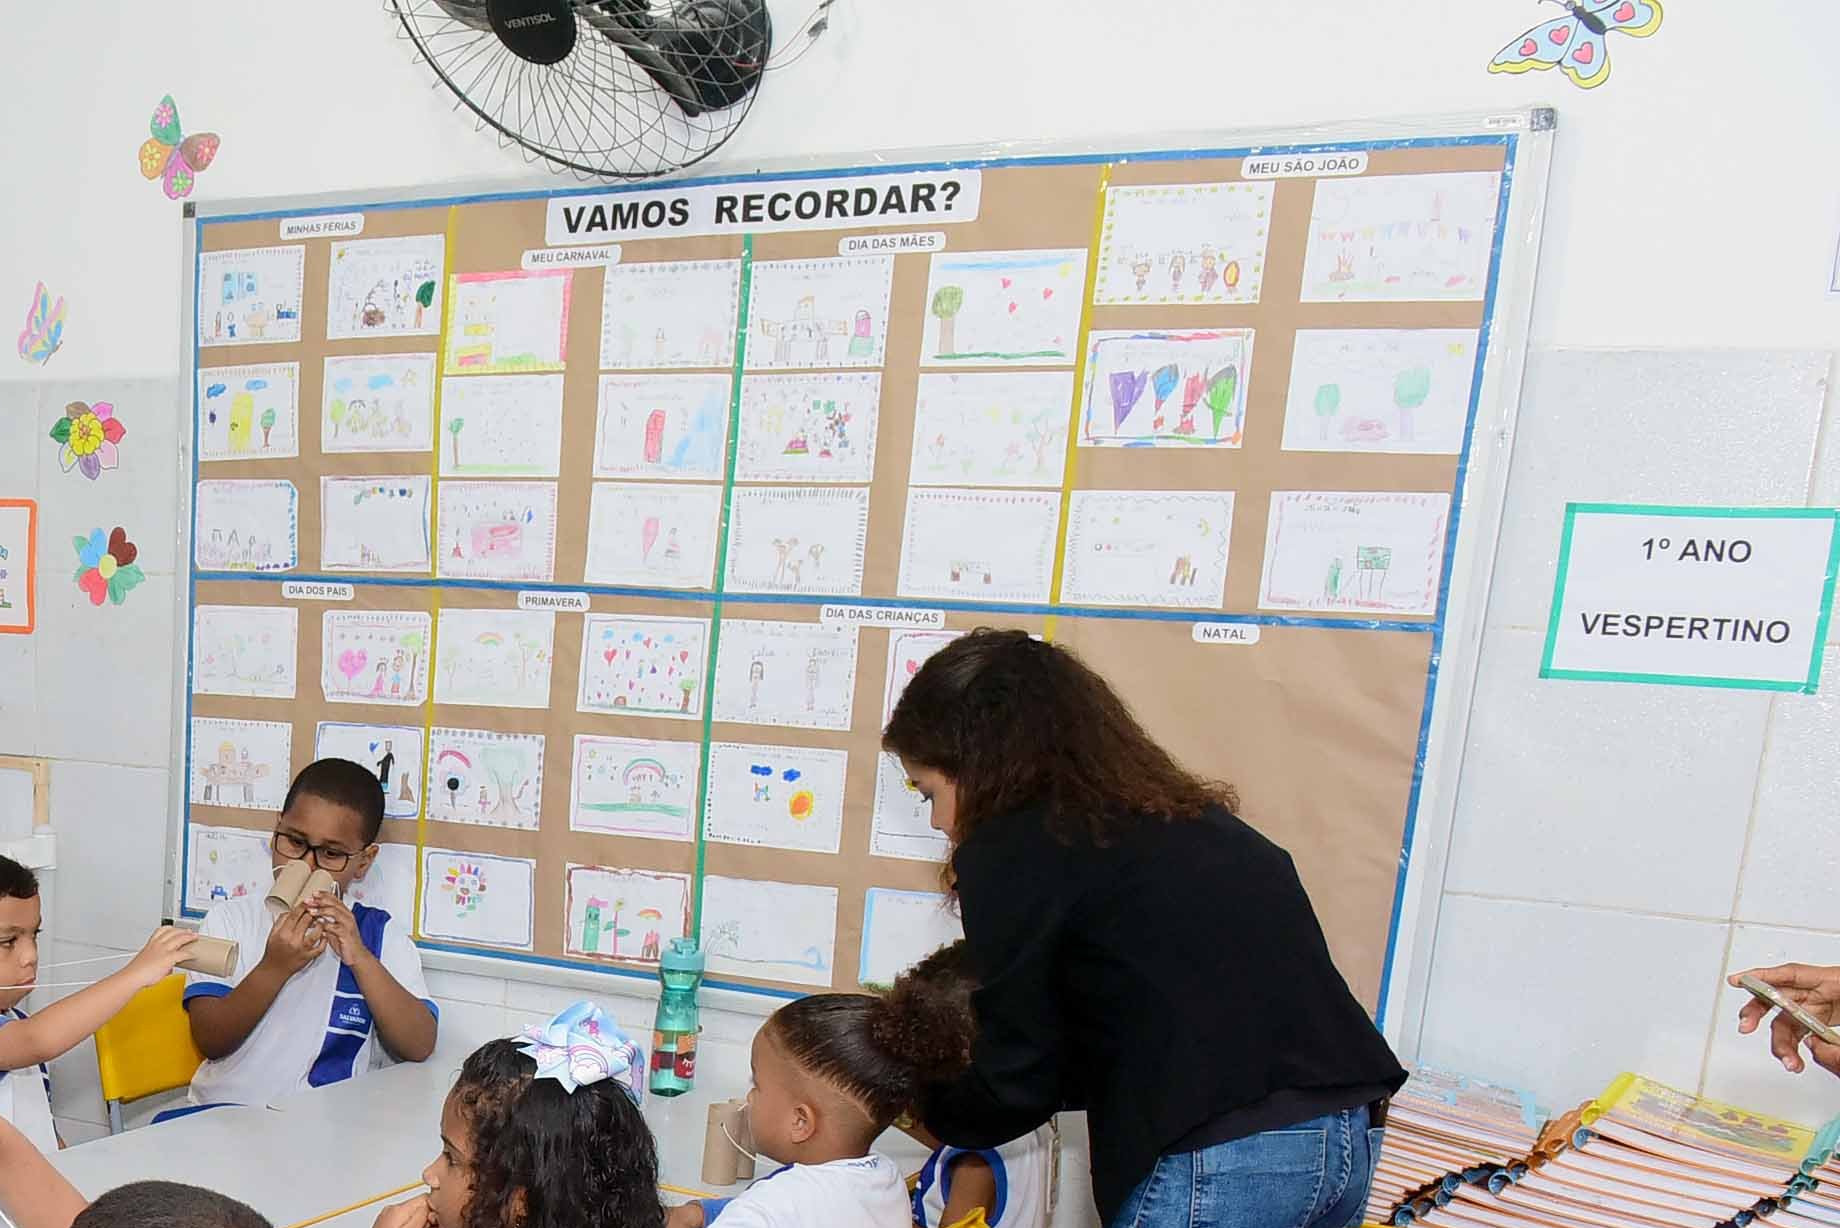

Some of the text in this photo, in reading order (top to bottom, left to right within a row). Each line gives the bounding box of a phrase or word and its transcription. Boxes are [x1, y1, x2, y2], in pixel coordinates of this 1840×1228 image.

[504, 12, 556, 29] VENTISOL
[1249, 155, 1360, 174] MEU SÃO JOÃO
[563, 180, 962, 233] VAMOS RECORDAR?
[287, 222, 320, 234] MINHAS
[848, 234, 935, 251] DIA DAS MÃES
[531, 250, 611, 263] MEU CARNAVAL
[1678, 540, 1752, 563] ANO
[288, 585, 348, 597] DIA DOS PAIS
[525, 596, 582, 608] PRIMAVERA
[825, 607, 939, 624] DIA DAS CRIANÇAS
[1202, 626, 1247, 641] NATAL
[1581, 612, 1791, 644] VESPERTINO
